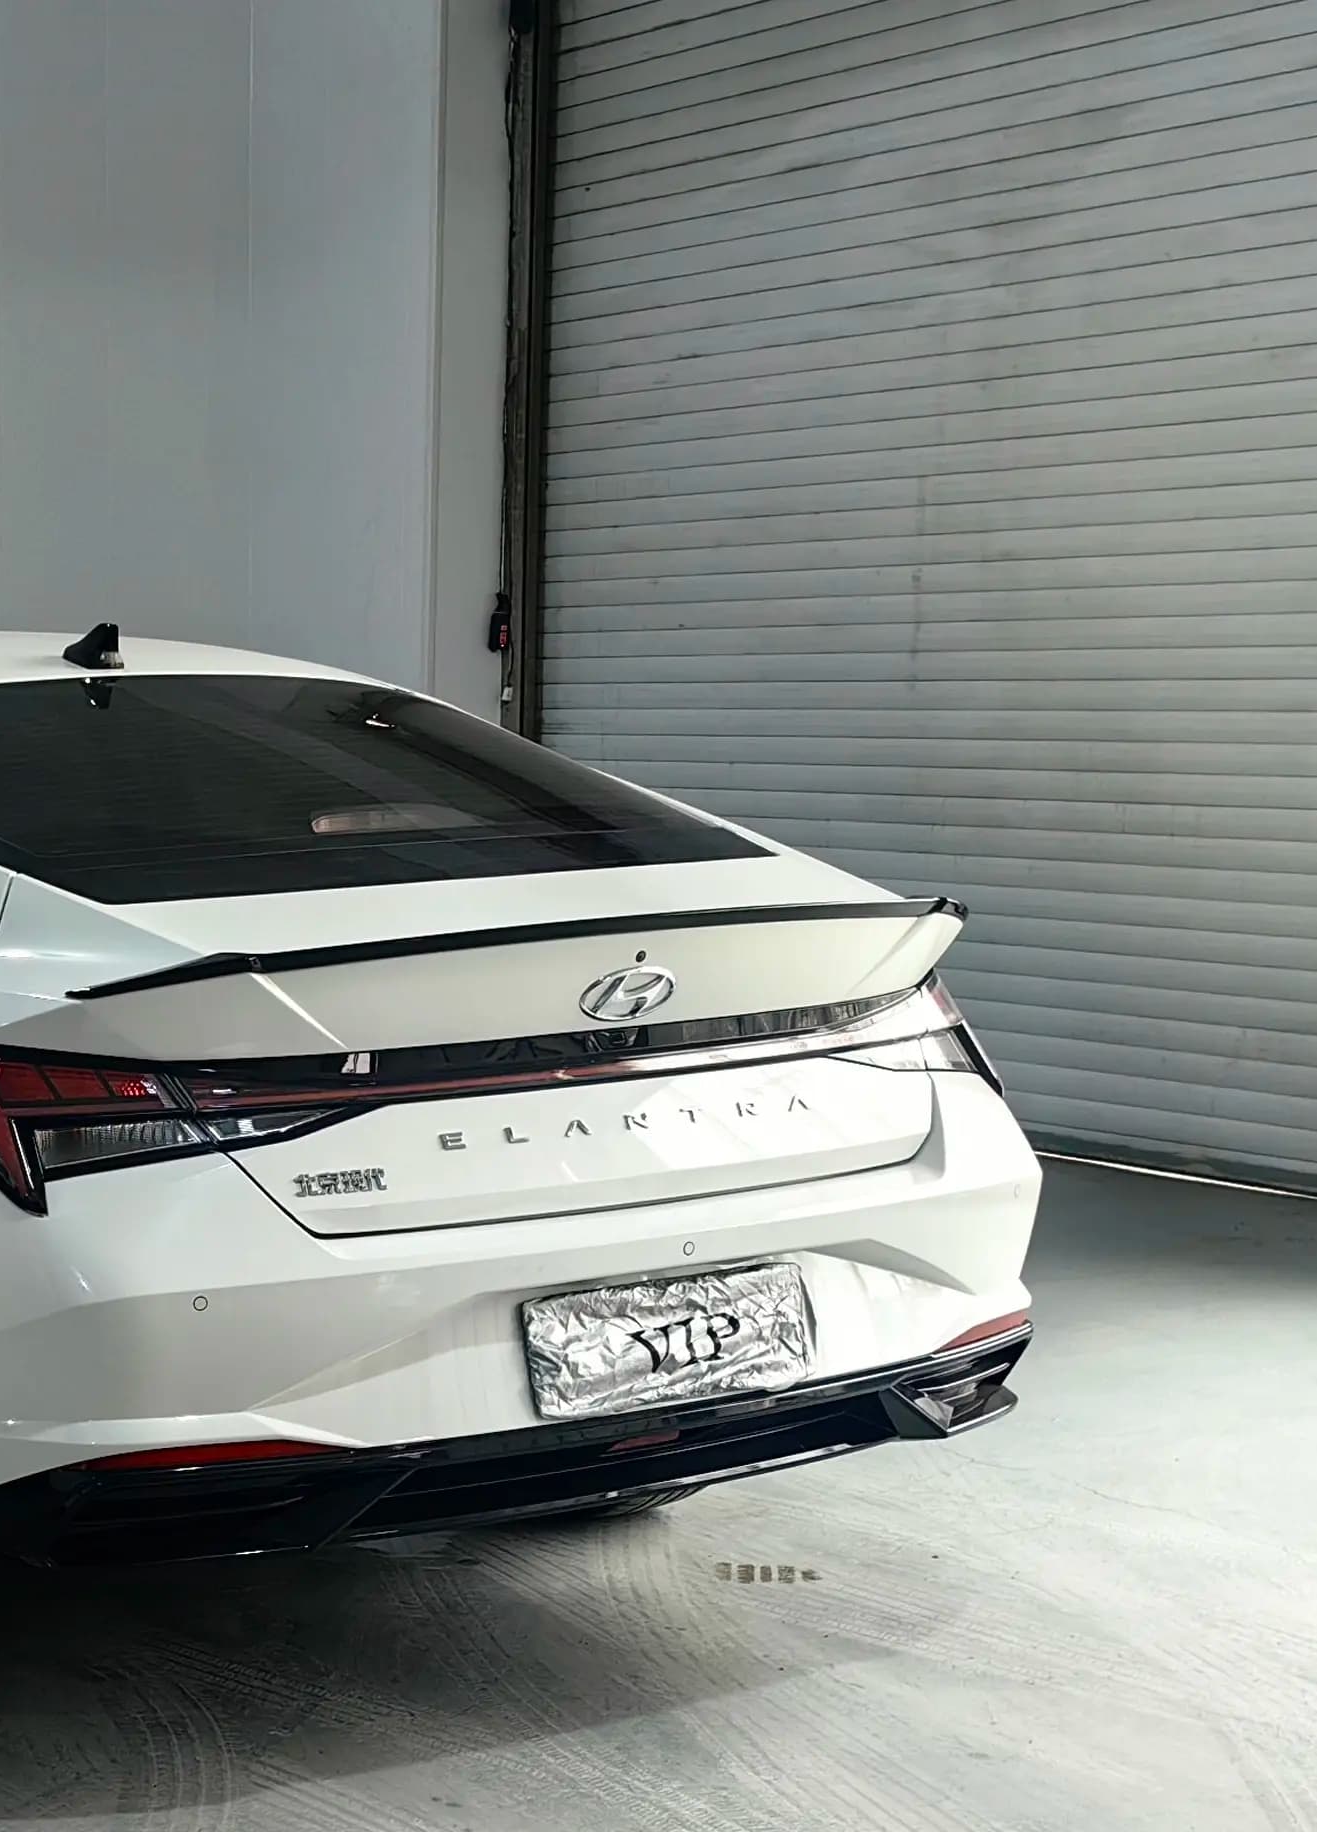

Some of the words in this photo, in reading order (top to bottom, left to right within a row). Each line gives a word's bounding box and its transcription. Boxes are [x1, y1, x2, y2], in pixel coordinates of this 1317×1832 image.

[293, 1168, 387, 1197] 北京现代
[625, 1312, 741, 1373] VIP
